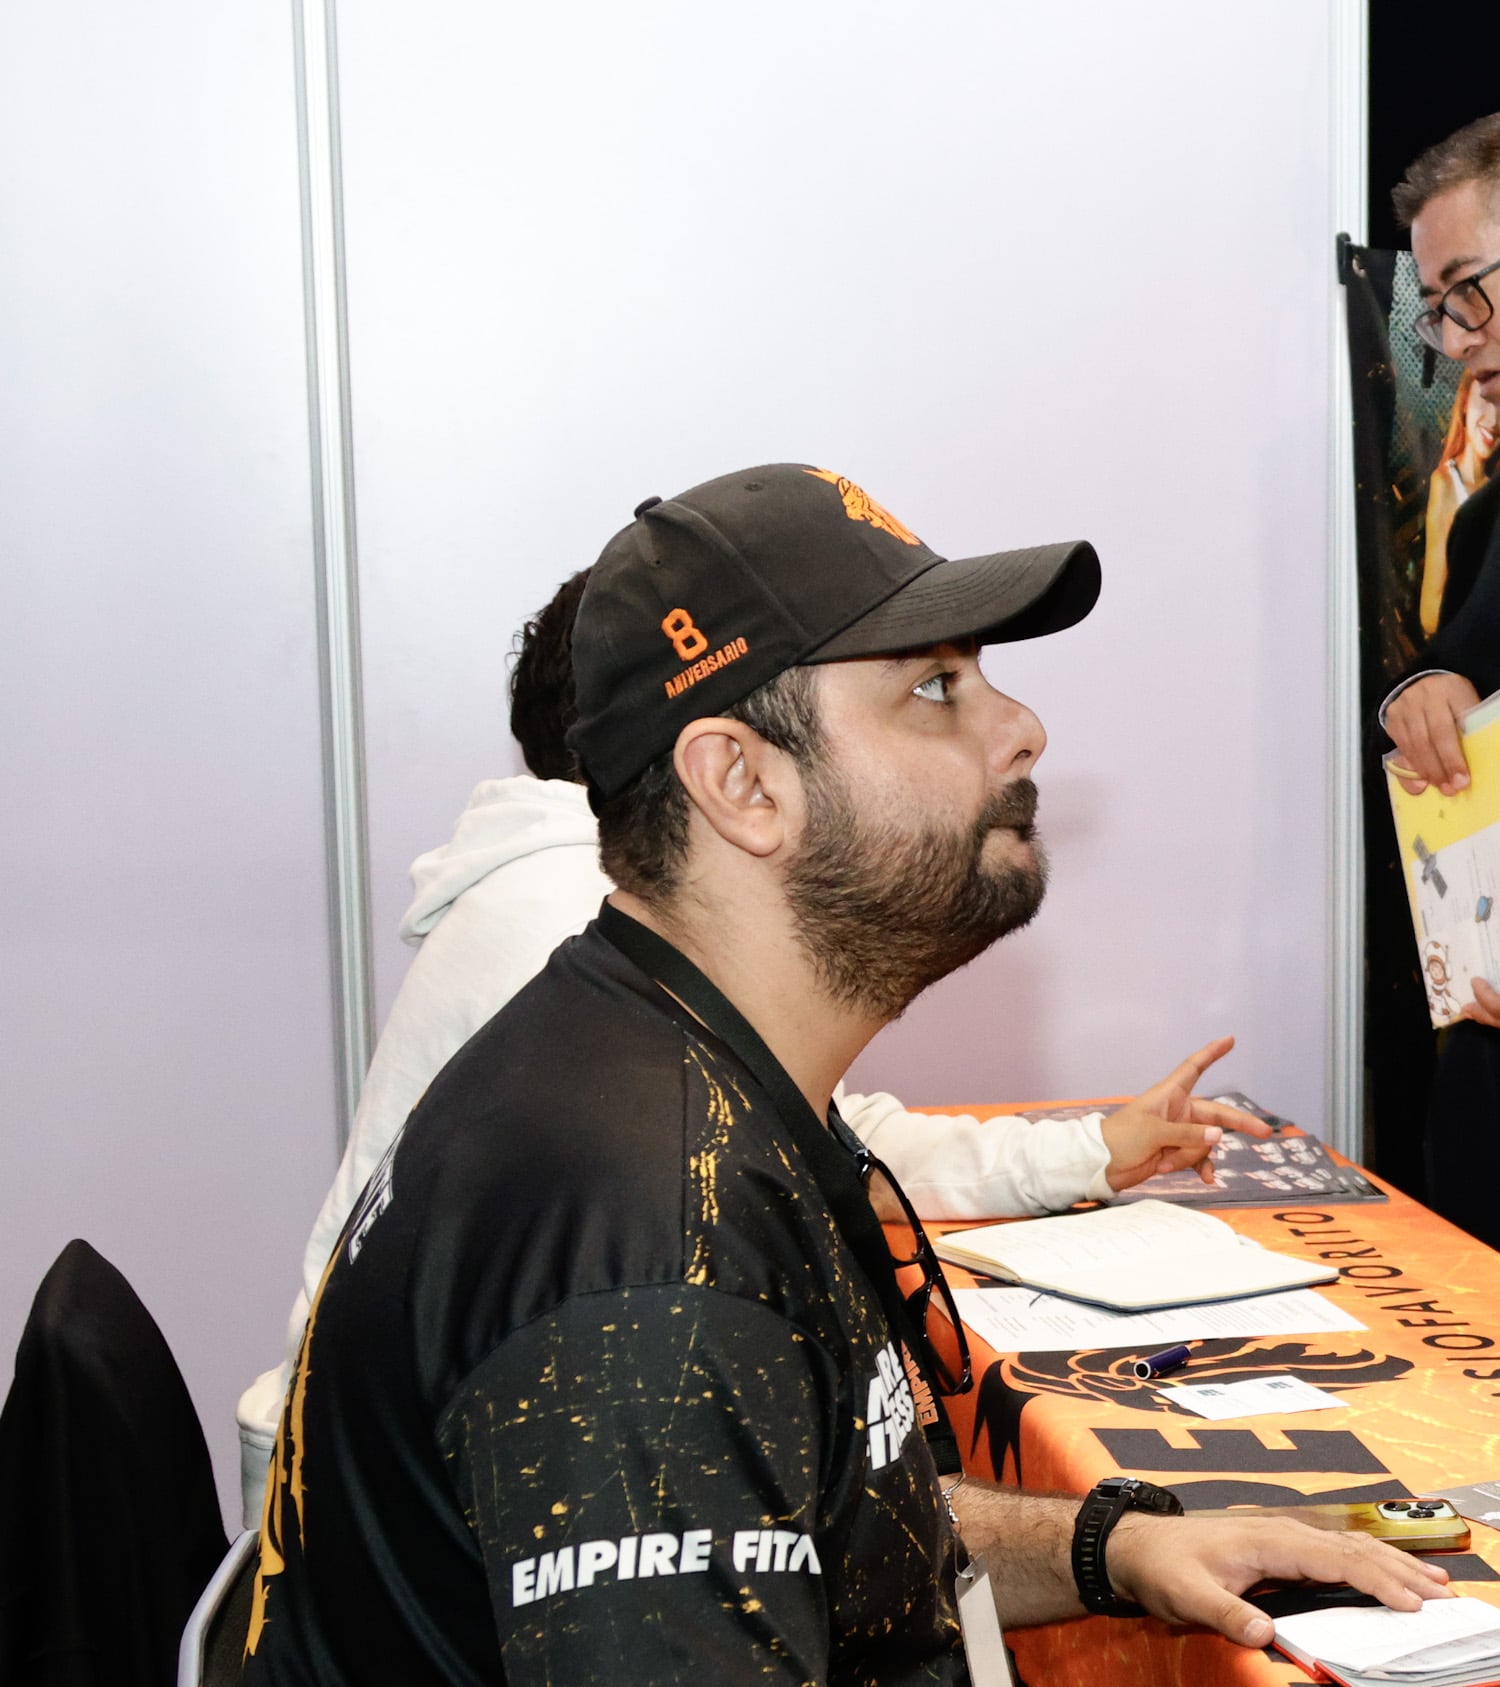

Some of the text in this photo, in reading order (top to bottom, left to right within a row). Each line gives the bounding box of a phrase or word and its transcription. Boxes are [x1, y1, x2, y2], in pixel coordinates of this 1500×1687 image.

[661, 607, 708, 661] 8
[664, 637, 749, 699] ANIVERSARIO
[512, 1529, 712, 1607] EMPIRE
